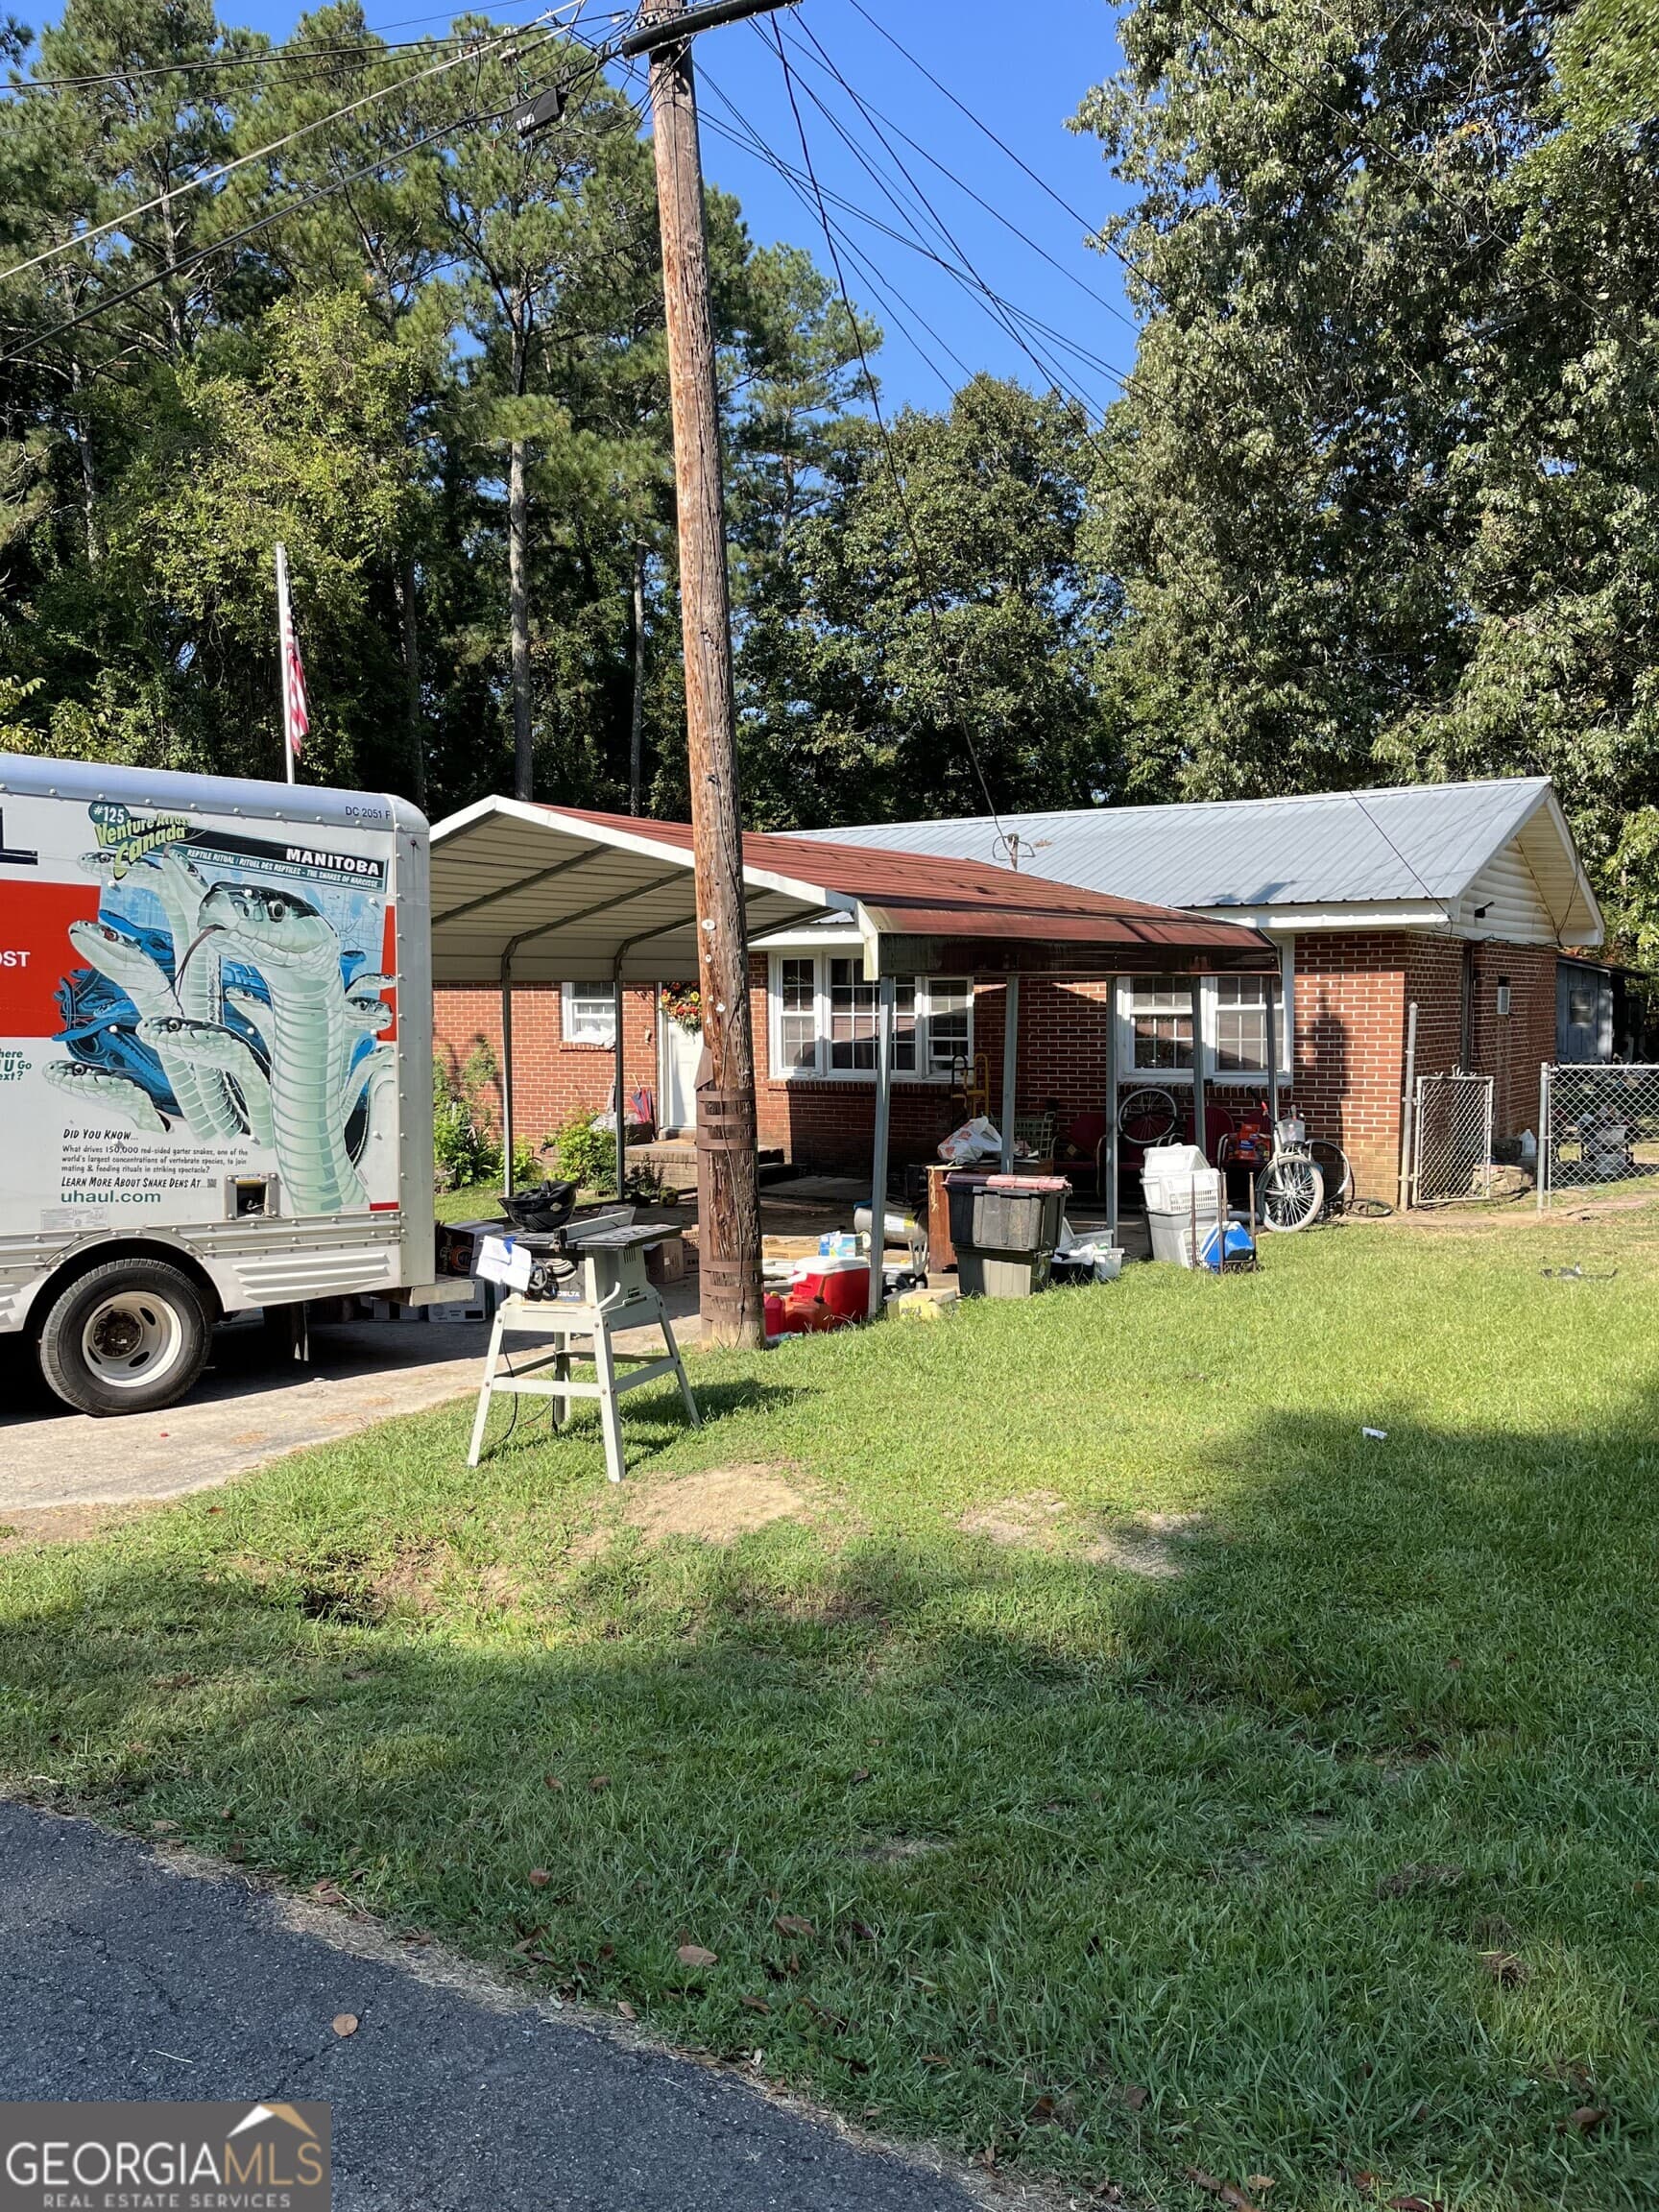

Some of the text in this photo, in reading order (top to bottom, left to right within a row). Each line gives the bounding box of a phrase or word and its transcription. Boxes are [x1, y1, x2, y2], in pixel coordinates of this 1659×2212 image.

[93, 805, 125, 823] #125
[346, 805, 391, 820] DC 2051 F
[94, 817, 155, 849] Venture
[113, 825, 186, 880] Canada
[186, 849, 212, 860] REPTILE
[212, 853, 234, 864] RITUAL
[238, 857, 260, 869] RITUEL
[274, 863, 301, 876] REPTILES
[307, 869, 318, 878] THE
[318, 870, 341, 881] SNAKES
[341, 875, 350, 883] OF
[285, 848, 379, 876] MANITOBA
[0, 950, 31, 967] ST
[4, 1059, 32, 1072] U Go
[62, 1144, 81, 1153] What
[83, 1144, 103, 1153] drives
[106, 1145, 138, 1154] 150,000
[140, 1145, 171, 1154] red-sided
[173, 1147, 191, 1156] garter
[61, 1154, 85, 1163] world's
[87, 1154, 110, 1164] largest
[60, 1165, 84, 1173] mating
[96, 1165, 120, 1173] feeding
[153, 1166, 176, 1174] striking
[178, 1166, 210, 1174] spectacle?
[60, 1190, 161, 1203] uhaul.com
